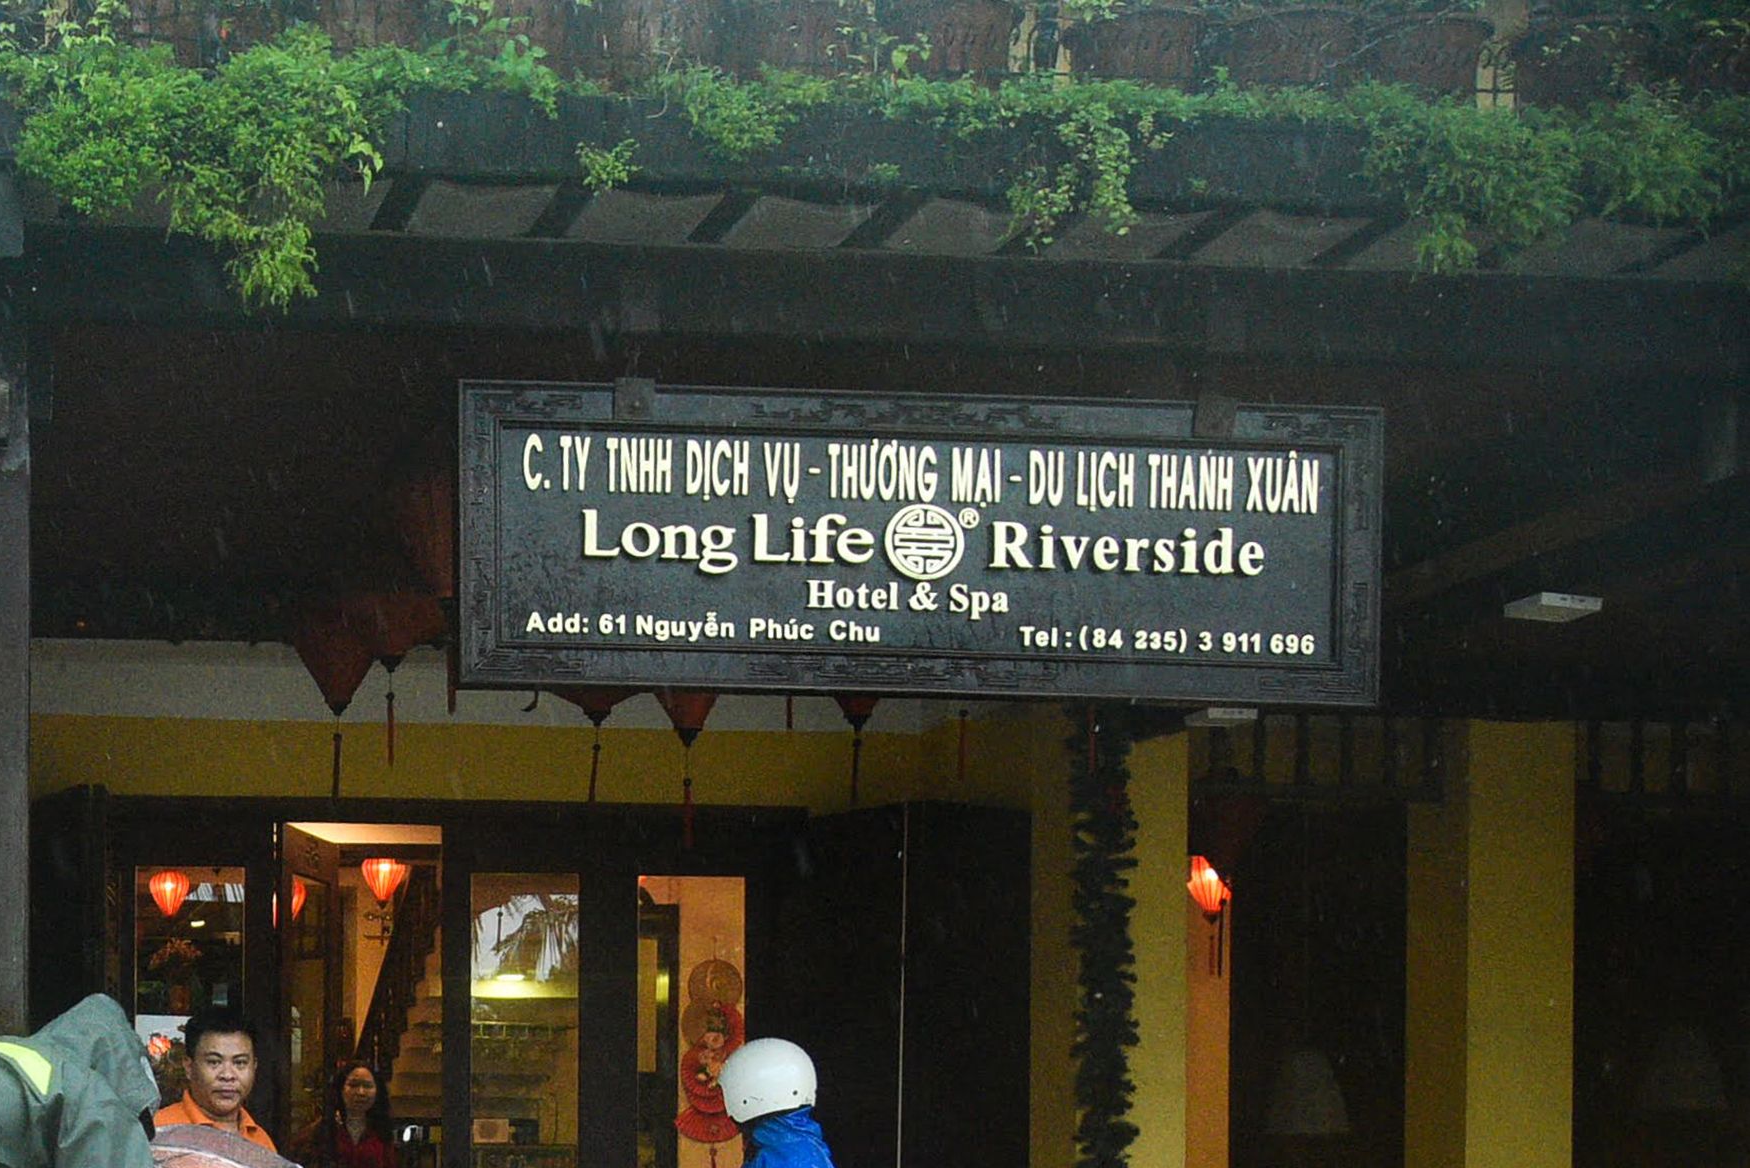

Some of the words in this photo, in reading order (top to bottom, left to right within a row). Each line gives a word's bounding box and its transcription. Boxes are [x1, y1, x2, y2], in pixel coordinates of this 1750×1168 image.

[523, 433, 550, 491] C.
[560, 435, 591, 491] TY
[606, 437, 672, 493] TNHH
[686, 439, 749, 501] DỊCH
[764, 442, 800, 504] VỤ
[951, 447, 1000, 508] MẠI
[1029, 450, 1064, 506] DU
[1076, 451, 1135, 512] LỊCH
[1246, 451, 1319, 514] XUÂN
[582, 509, 738, 574] Long
[752, 513, 875, 564] Life
[989, 520, 1265, 576] Riverside
[806, 579, 899, 611] Hotel
[908, 581, 938, 611] &
[949, 583, 1009, 620] Spa
[526, 611, 589, 633] Add:
[598, 614, 626, 634] 61
[636, 611, 735, 642] Nguyễn
[750, 618, 814, 640] Phúc
[829, 621, 880, 642] Chu
[1134, 630, 1188, 653] 235)
[1199, 632, 1212, 651] 3
[1223, 632, 1261, 653] 911
[1269, 634, 1315, 655] 696
